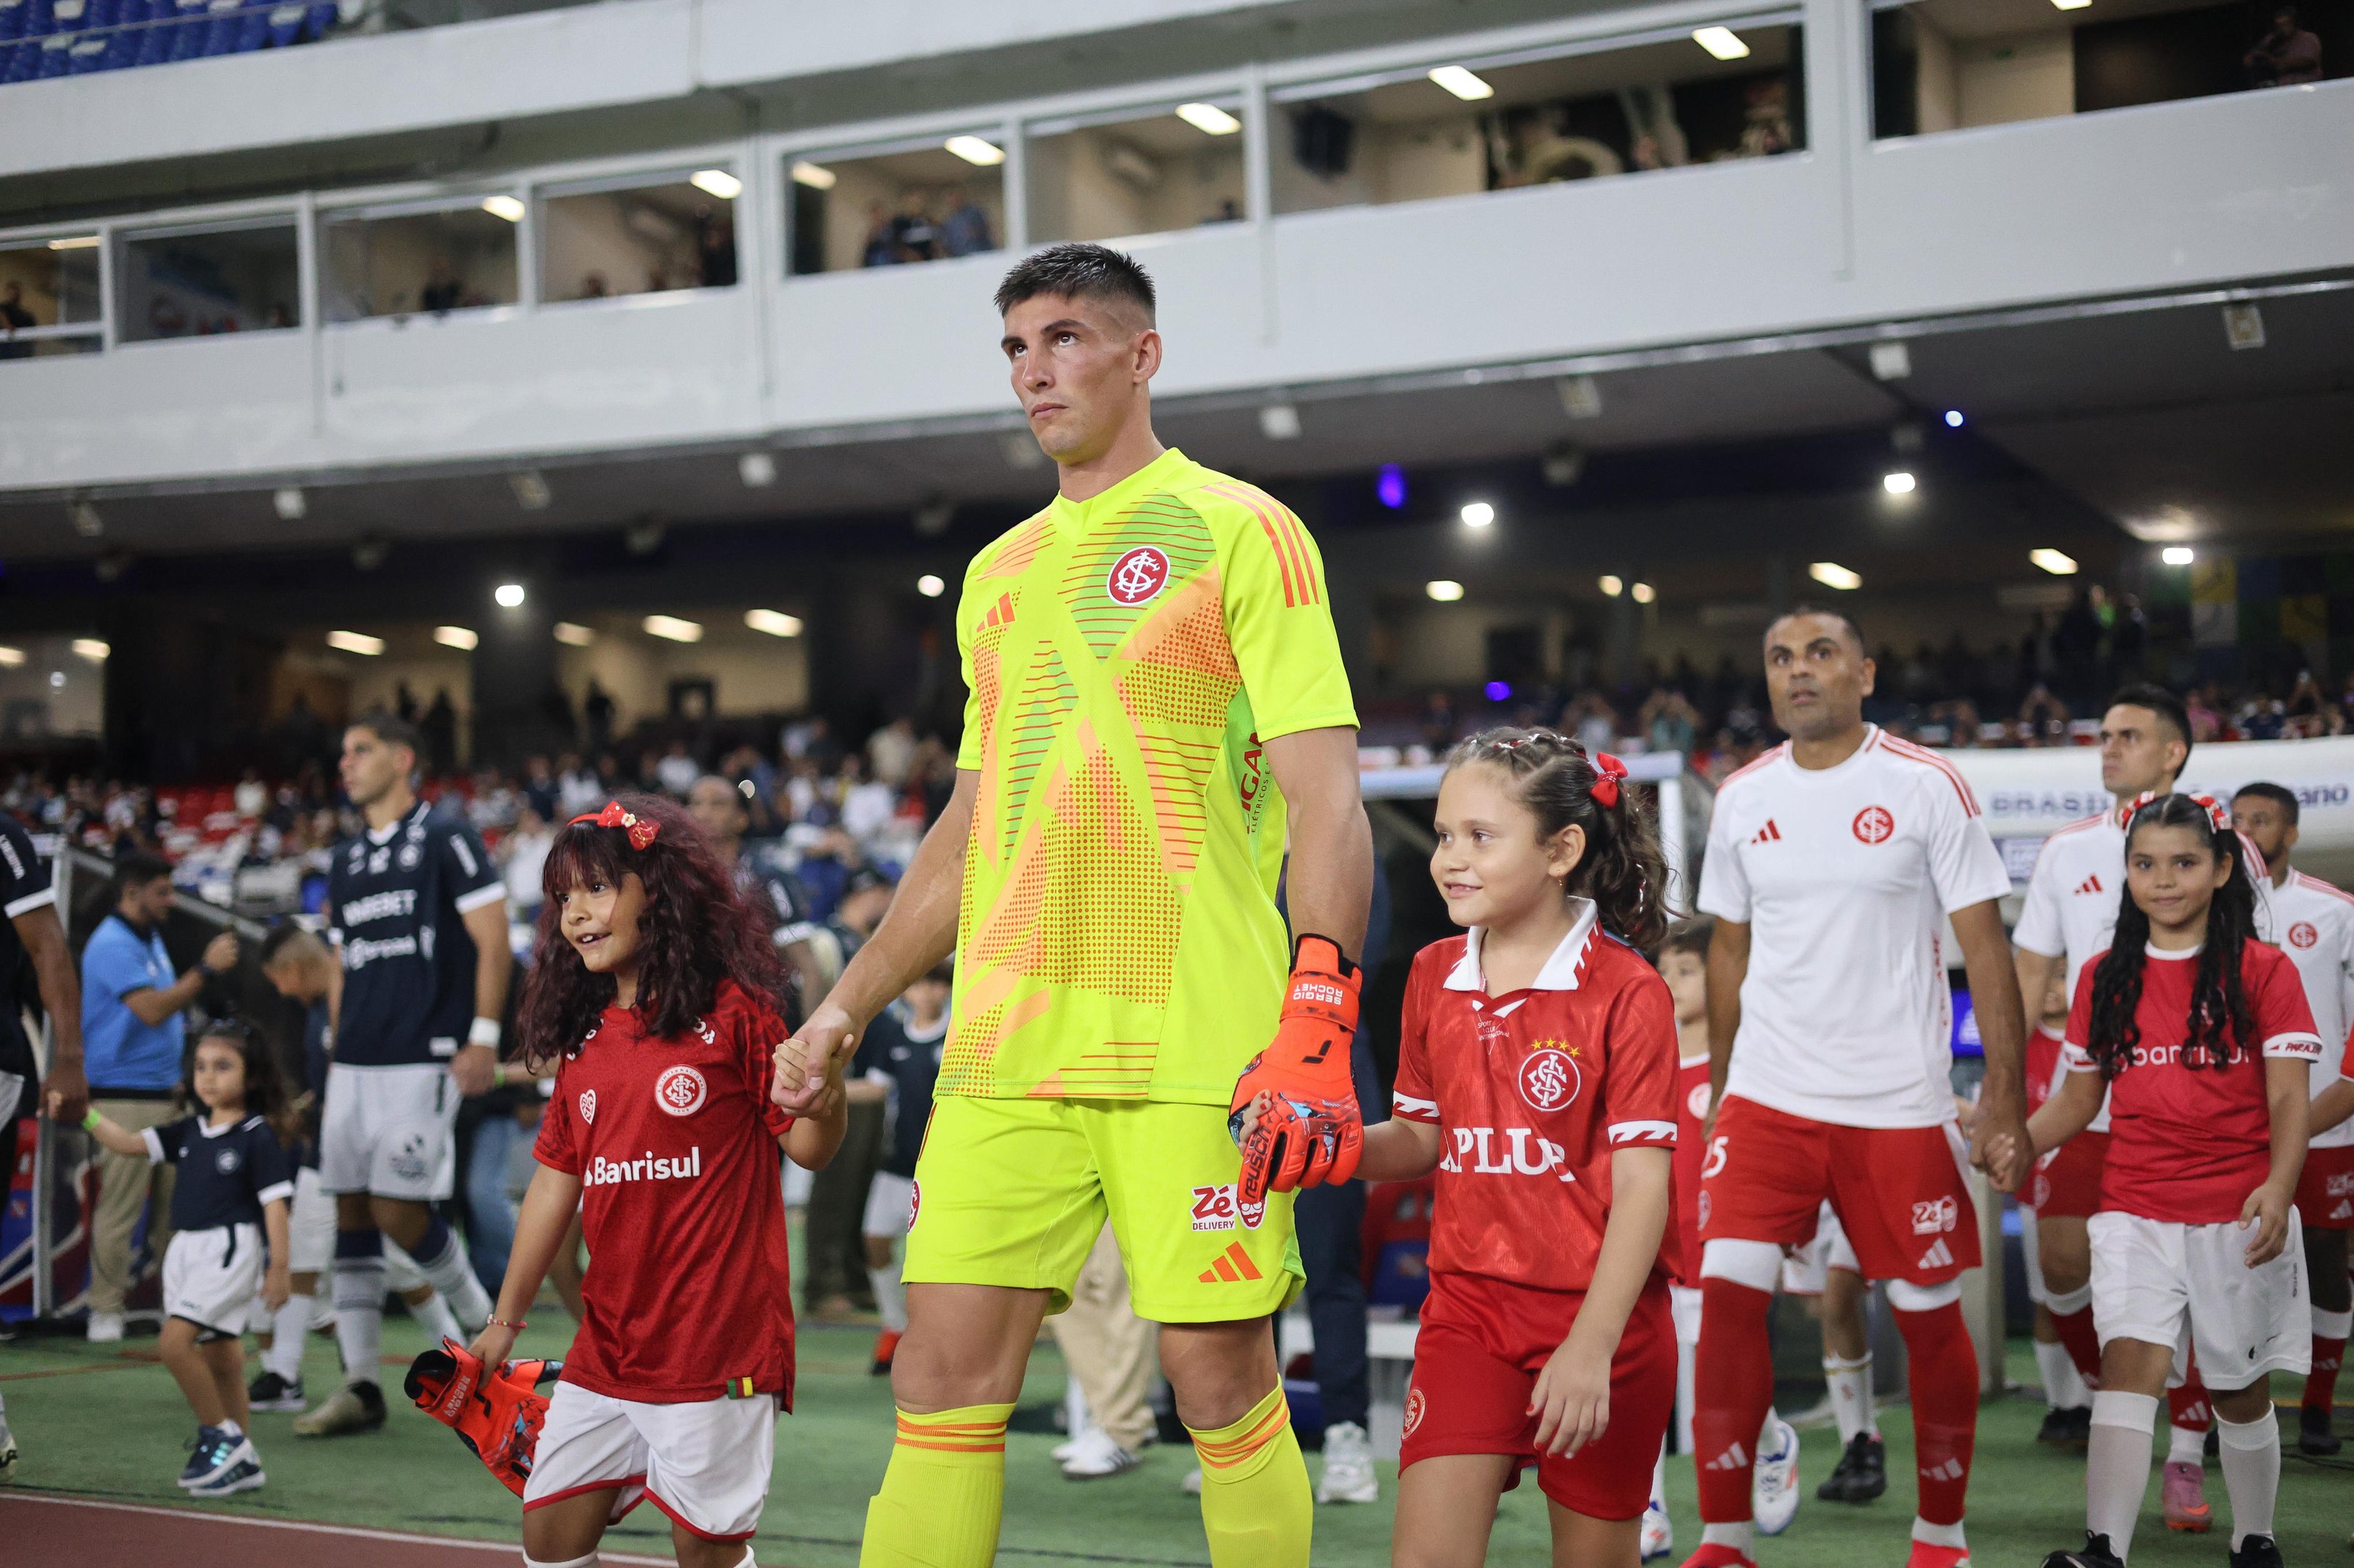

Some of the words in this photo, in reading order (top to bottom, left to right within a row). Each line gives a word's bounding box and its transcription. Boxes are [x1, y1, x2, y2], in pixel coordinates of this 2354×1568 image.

[1294, 984, 1343, 997] ROCHET
[1293, 992, 1342, 1005] SERGIO
[1477, 1020, 1492, 1029] SPORT
[594, 1146, 700, 1185] Banrisul
[1244, 1126, 1272, 1199] reusch
[1192, 1185, 1234, 1220] Zé
[1193, 1220, 1235, 1230] DELIVERY
